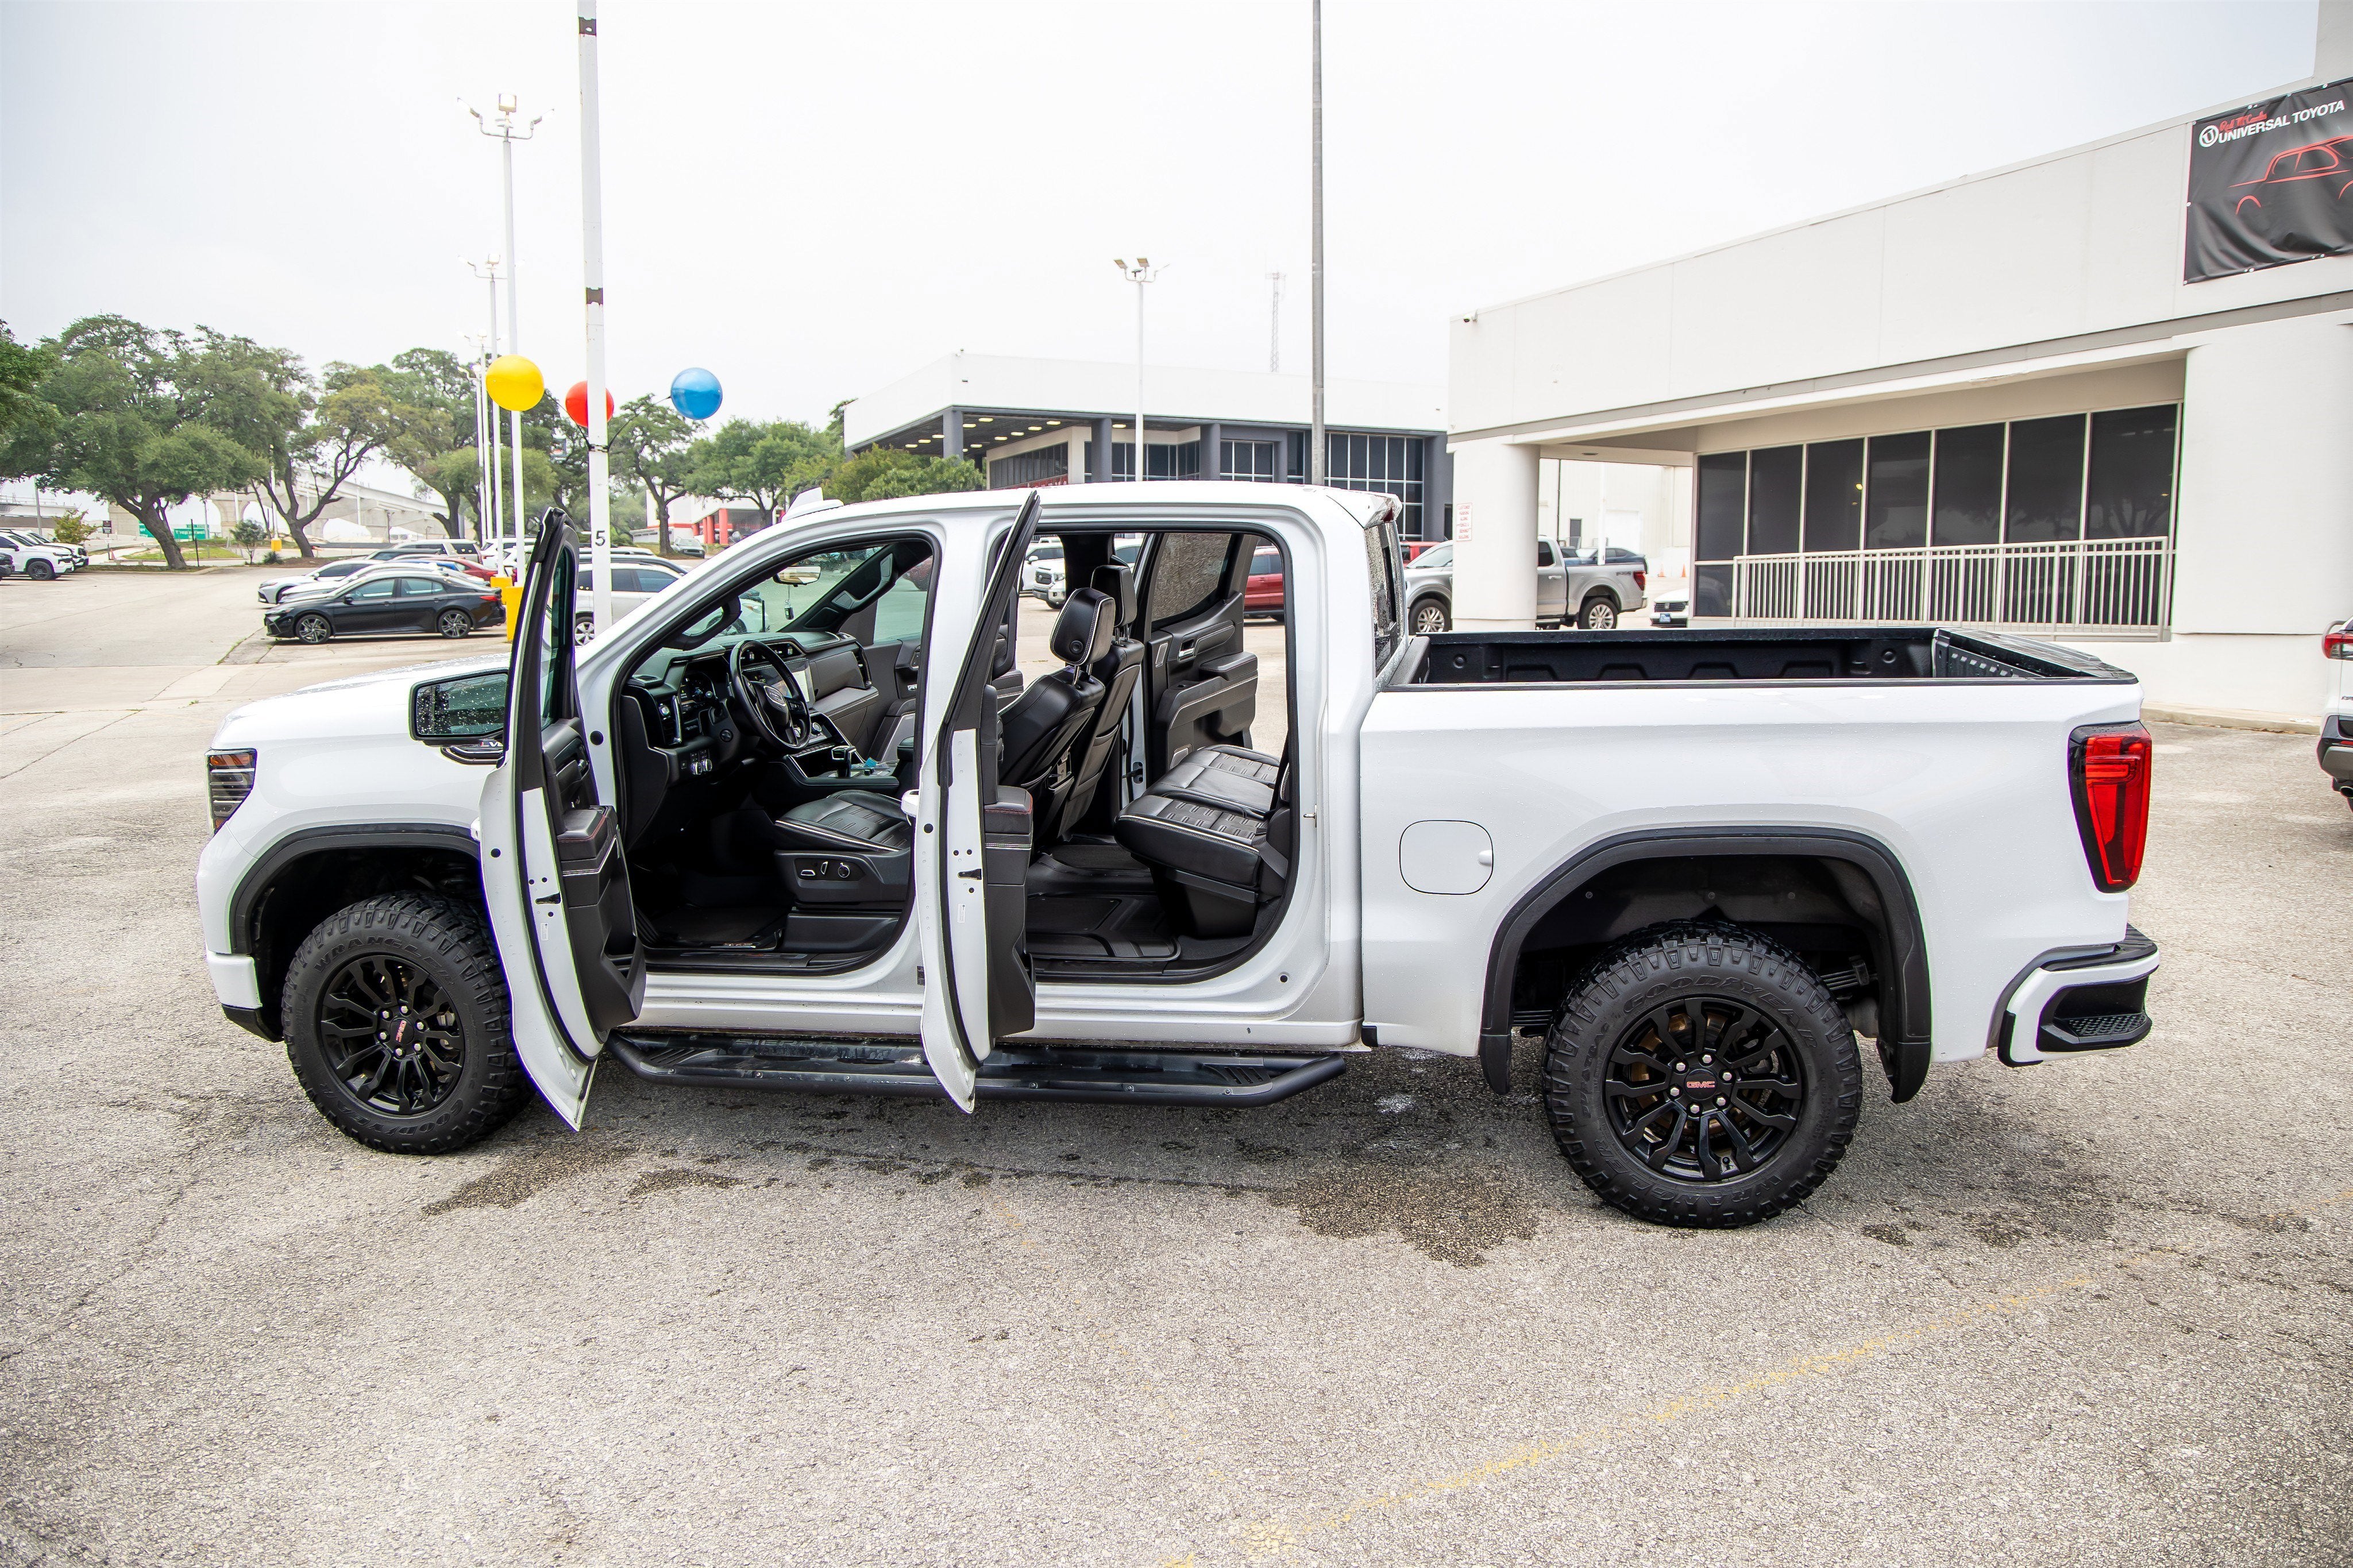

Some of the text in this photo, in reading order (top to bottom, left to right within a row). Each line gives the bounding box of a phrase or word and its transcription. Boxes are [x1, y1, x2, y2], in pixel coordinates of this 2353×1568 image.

[2217, 114, 2291, 144] UNIVERSAL
[2291, 99, 2345, 124] TOYOTA
[595, 530, 606, 546] 5
[314, 936, 455, 986] WRANGLER
[395, 1020, 407, 1042] GMC
[1623, 975, 1818, 1049] GOODYEAR
[1595, 1139, 1783, 1207] WRANGLER
